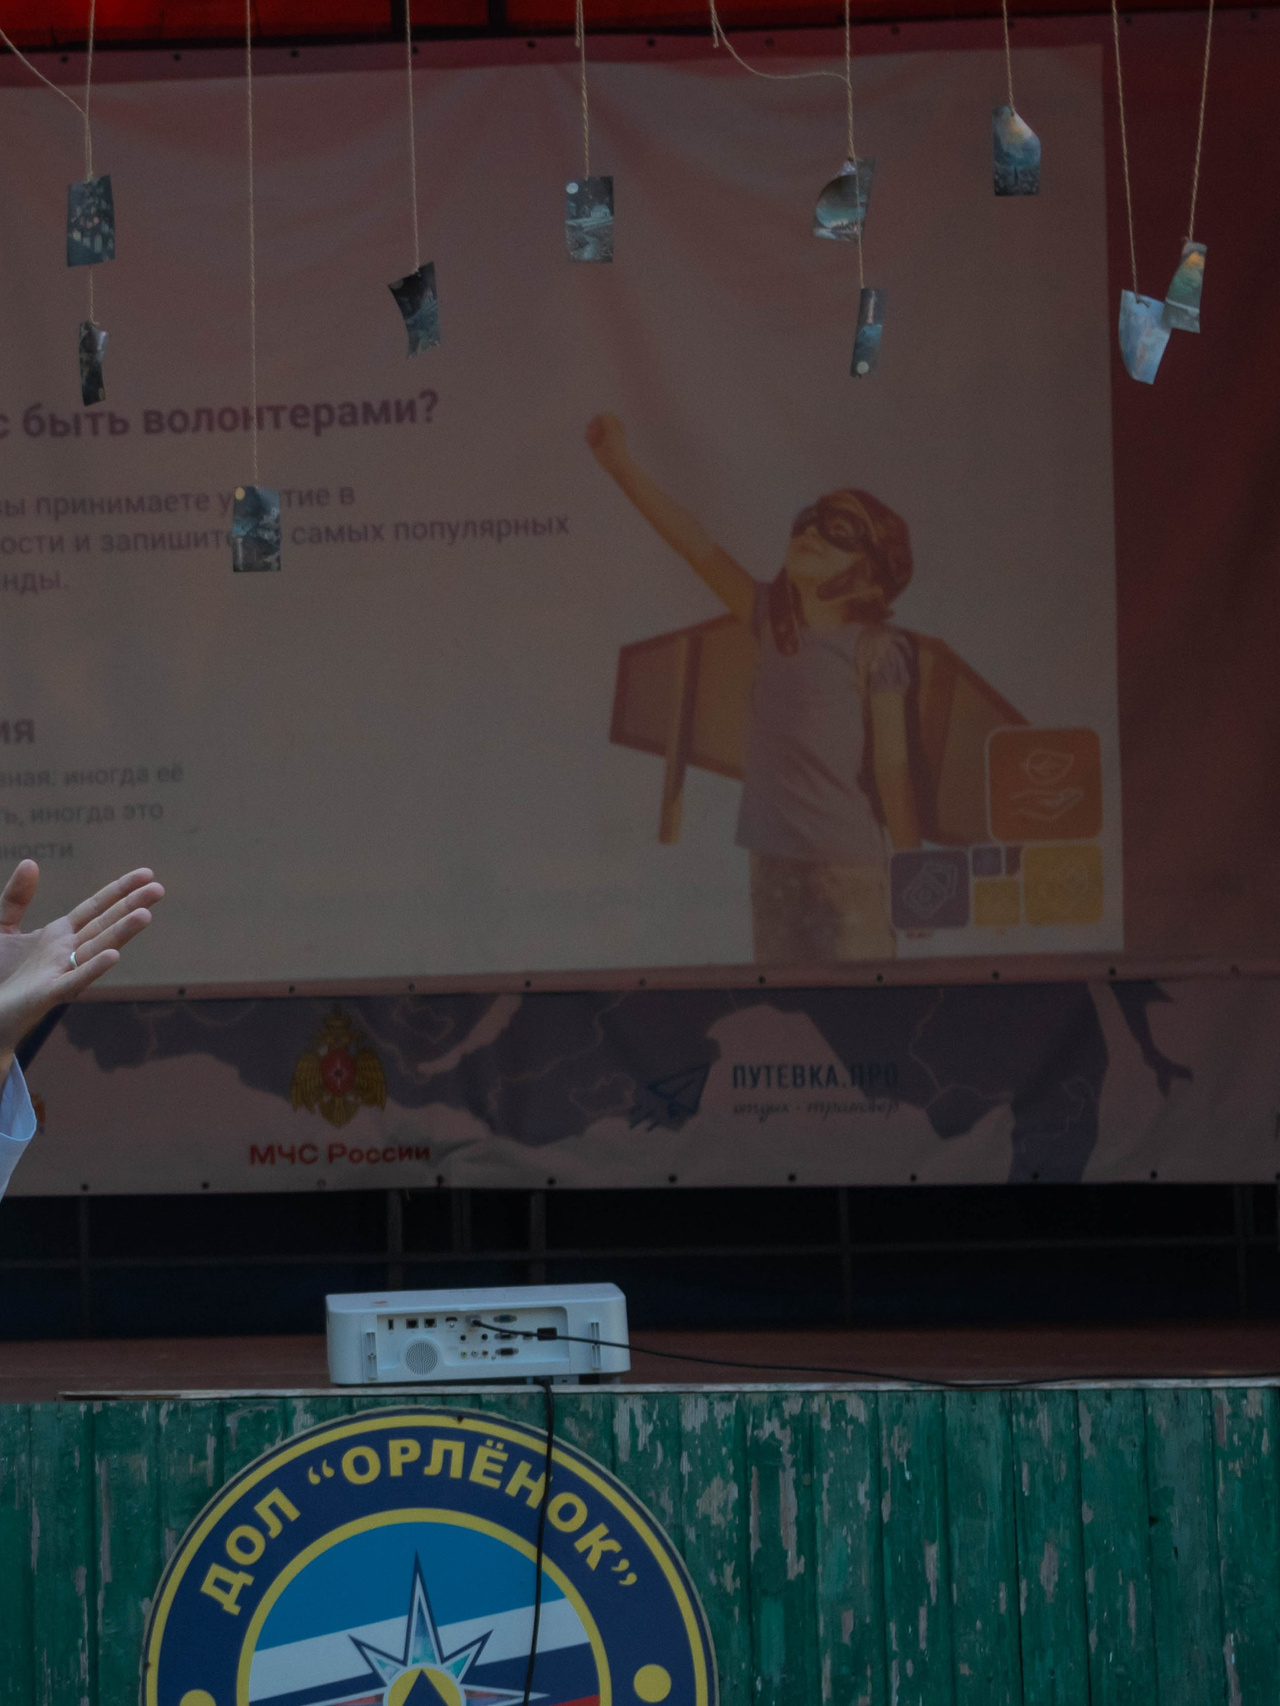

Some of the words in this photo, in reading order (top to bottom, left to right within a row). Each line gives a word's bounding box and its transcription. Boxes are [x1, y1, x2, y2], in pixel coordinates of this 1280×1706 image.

[22, 402, 131, 439] быть
[143, 388, 440, 438] волонтерами?
[36, 491, 210, 524] принимаете
[220, 488, 330, 519] утие
[339, 486, 355, 506] в
[75, 535, 90, 553] и
[292, 523, 385, 546] самых
[394, 516, 570, 546] популярных
[64, 764, 150, 787] иногда
[30, 802, 116, 826] иногда
[123, 800, 165, 821] это
[731, 1061, 901, 1089] ПУТЕВКА.ПРО
[249, 1143, 319, 1166] МЧС
[327, 1142, 431, 1165] России
[200, 1487, 301, 1616] ДОЛ
